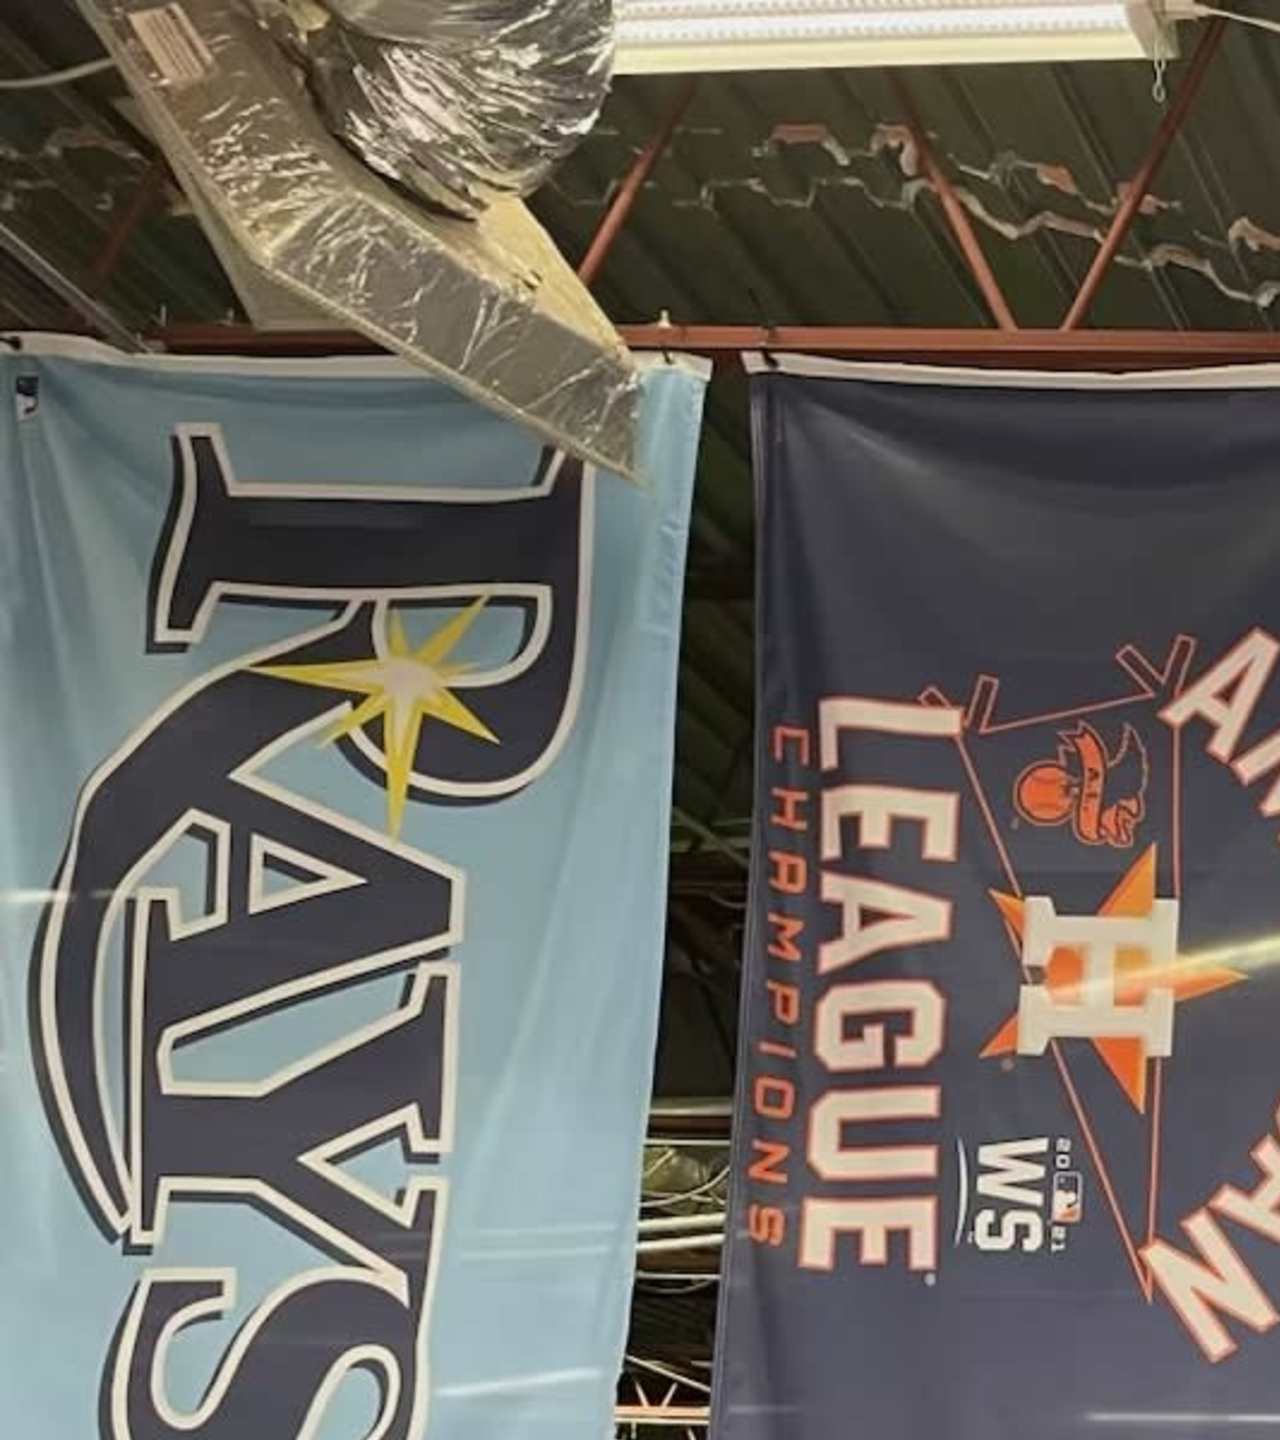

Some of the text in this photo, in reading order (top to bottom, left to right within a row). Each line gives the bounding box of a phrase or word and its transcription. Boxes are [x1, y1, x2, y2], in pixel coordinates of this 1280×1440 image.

[747, 725, 811, 1249] CHAMPIONS
[797, 694, 964, 1272] LEAGUE
[973, 1136, 1049, 1254] WS
